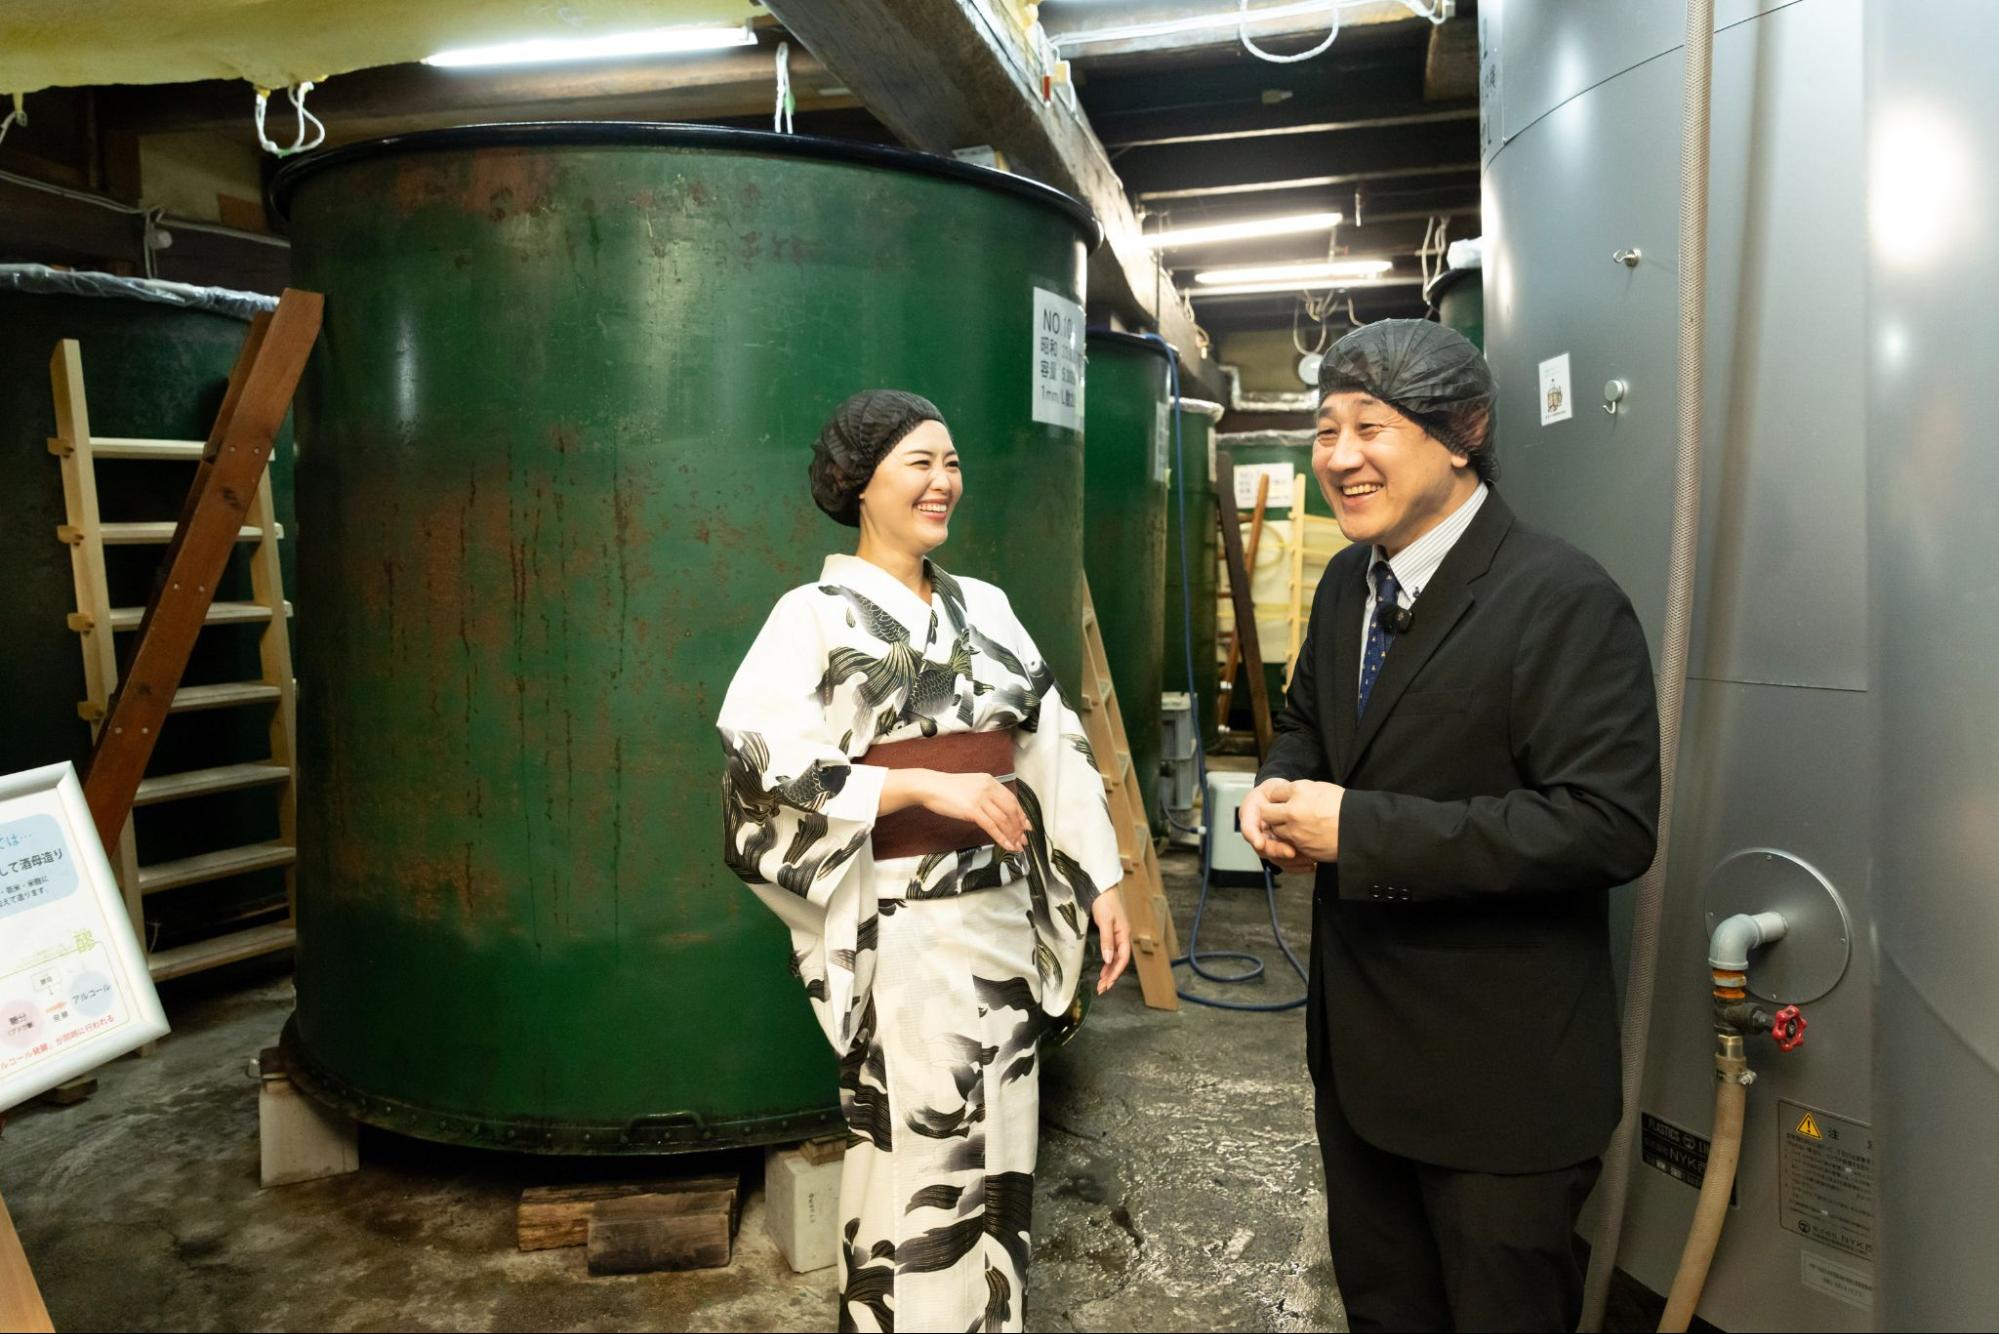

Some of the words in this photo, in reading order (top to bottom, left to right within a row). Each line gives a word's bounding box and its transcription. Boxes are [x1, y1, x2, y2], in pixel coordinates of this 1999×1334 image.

[72, 984, 111, 1005] アルコール
